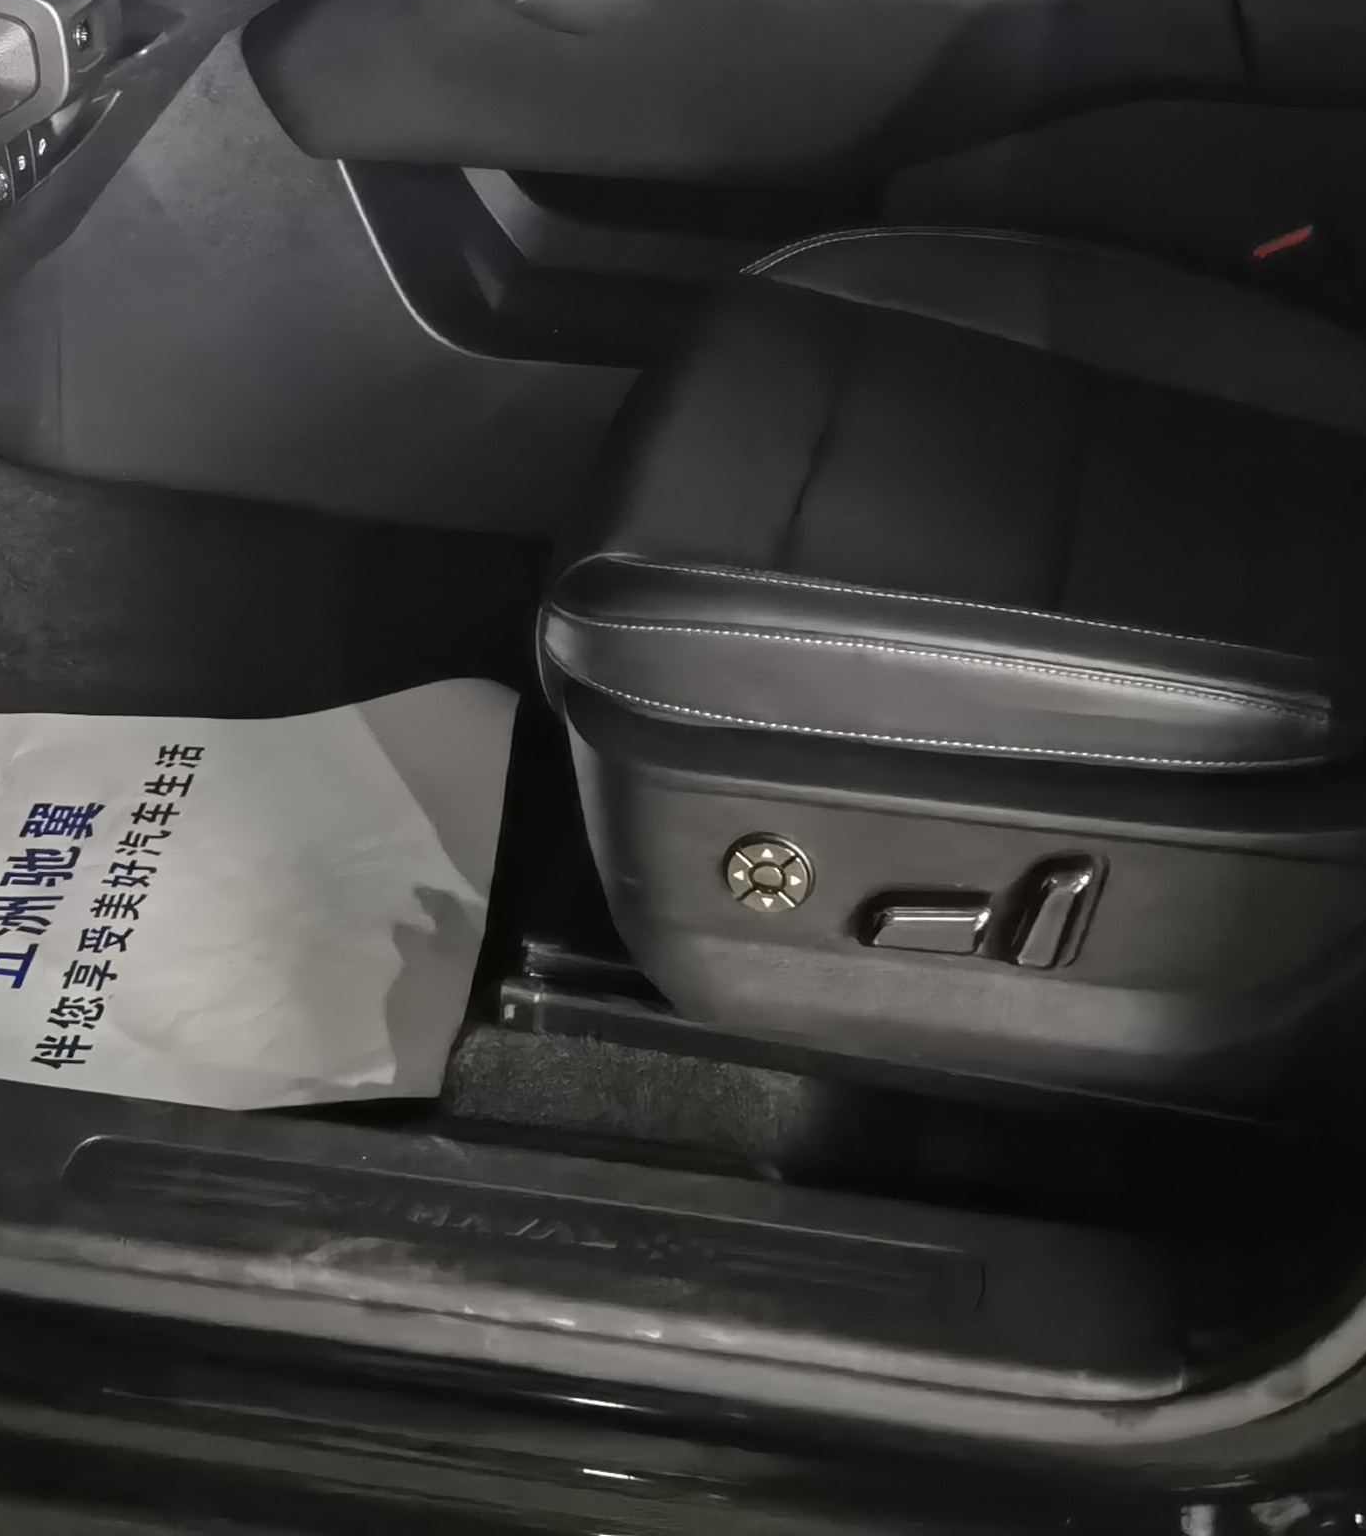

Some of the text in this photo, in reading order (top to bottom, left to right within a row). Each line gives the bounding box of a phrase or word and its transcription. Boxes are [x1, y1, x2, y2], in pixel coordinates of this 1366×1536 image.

[30, 744, 206, 1069] 伴您享受美好汽车生活
